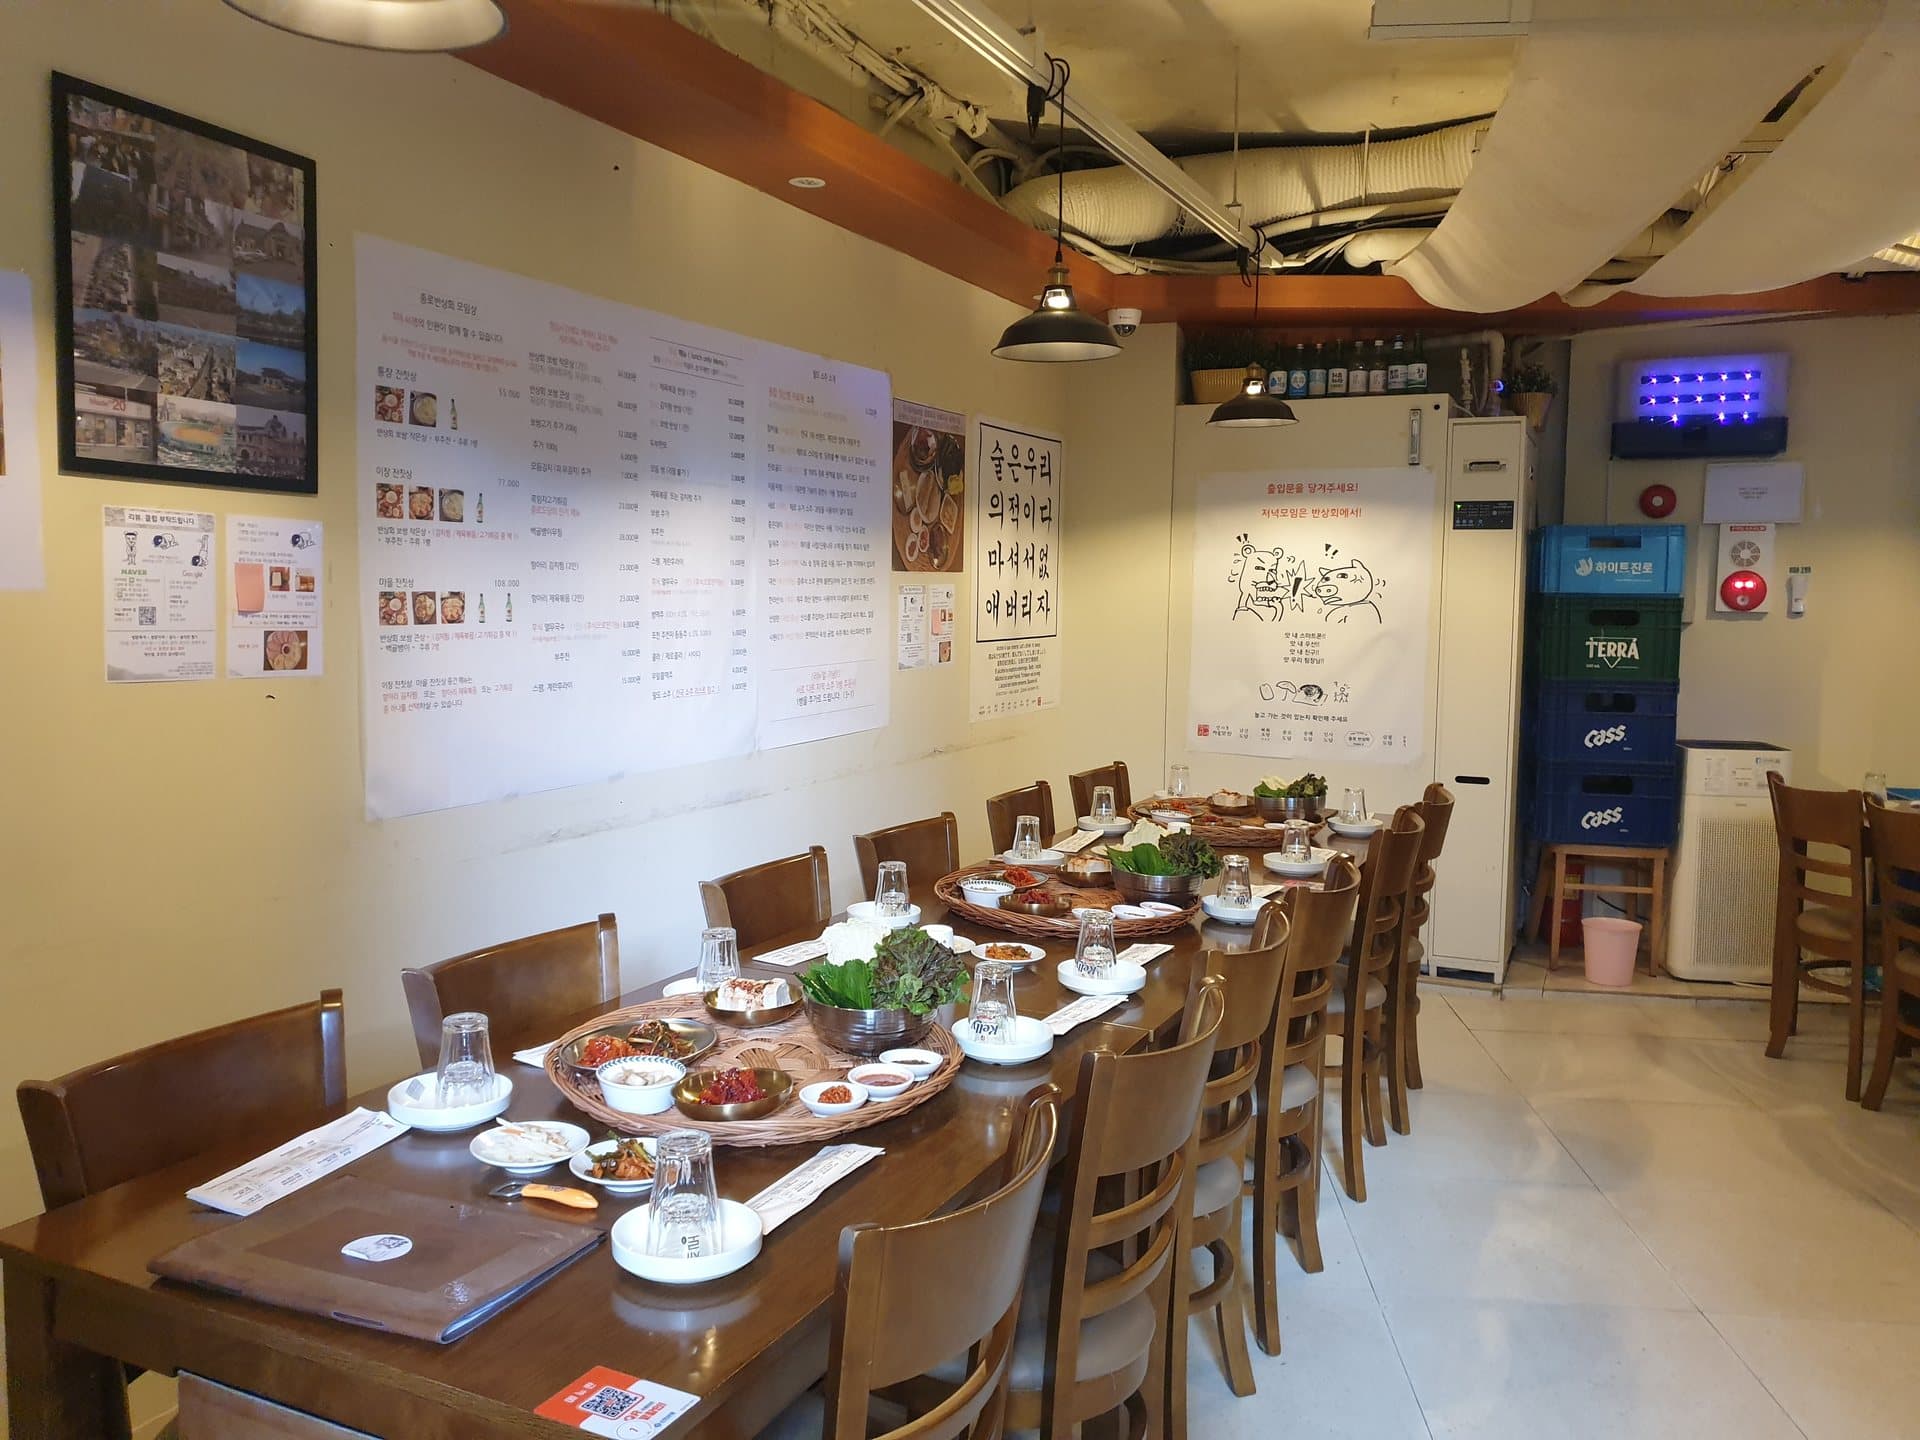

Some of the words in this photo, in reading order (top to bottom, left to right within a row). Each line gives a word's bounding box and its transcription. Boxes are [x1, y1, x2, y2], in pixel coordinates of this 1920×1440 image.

[1266, 483, 1304, 495] 출입문을
[1307, 482, 1359, 494] 당겨주세요!
[159, 516, 195, 525] 부탁드립니다
[1261, 507, 1308, 519] 저녁모임은
[1311, 507, 1362, 519] 반상회에서!
[1595, 560, 1653, 575] 하이트진로
[1586, 639, 1639, 660] TERRA
[1584, 725, 1627, 748] Cass
[1581, 806, 1623, 830] Cass
[971, 1020, 999, 1035] Kelly
